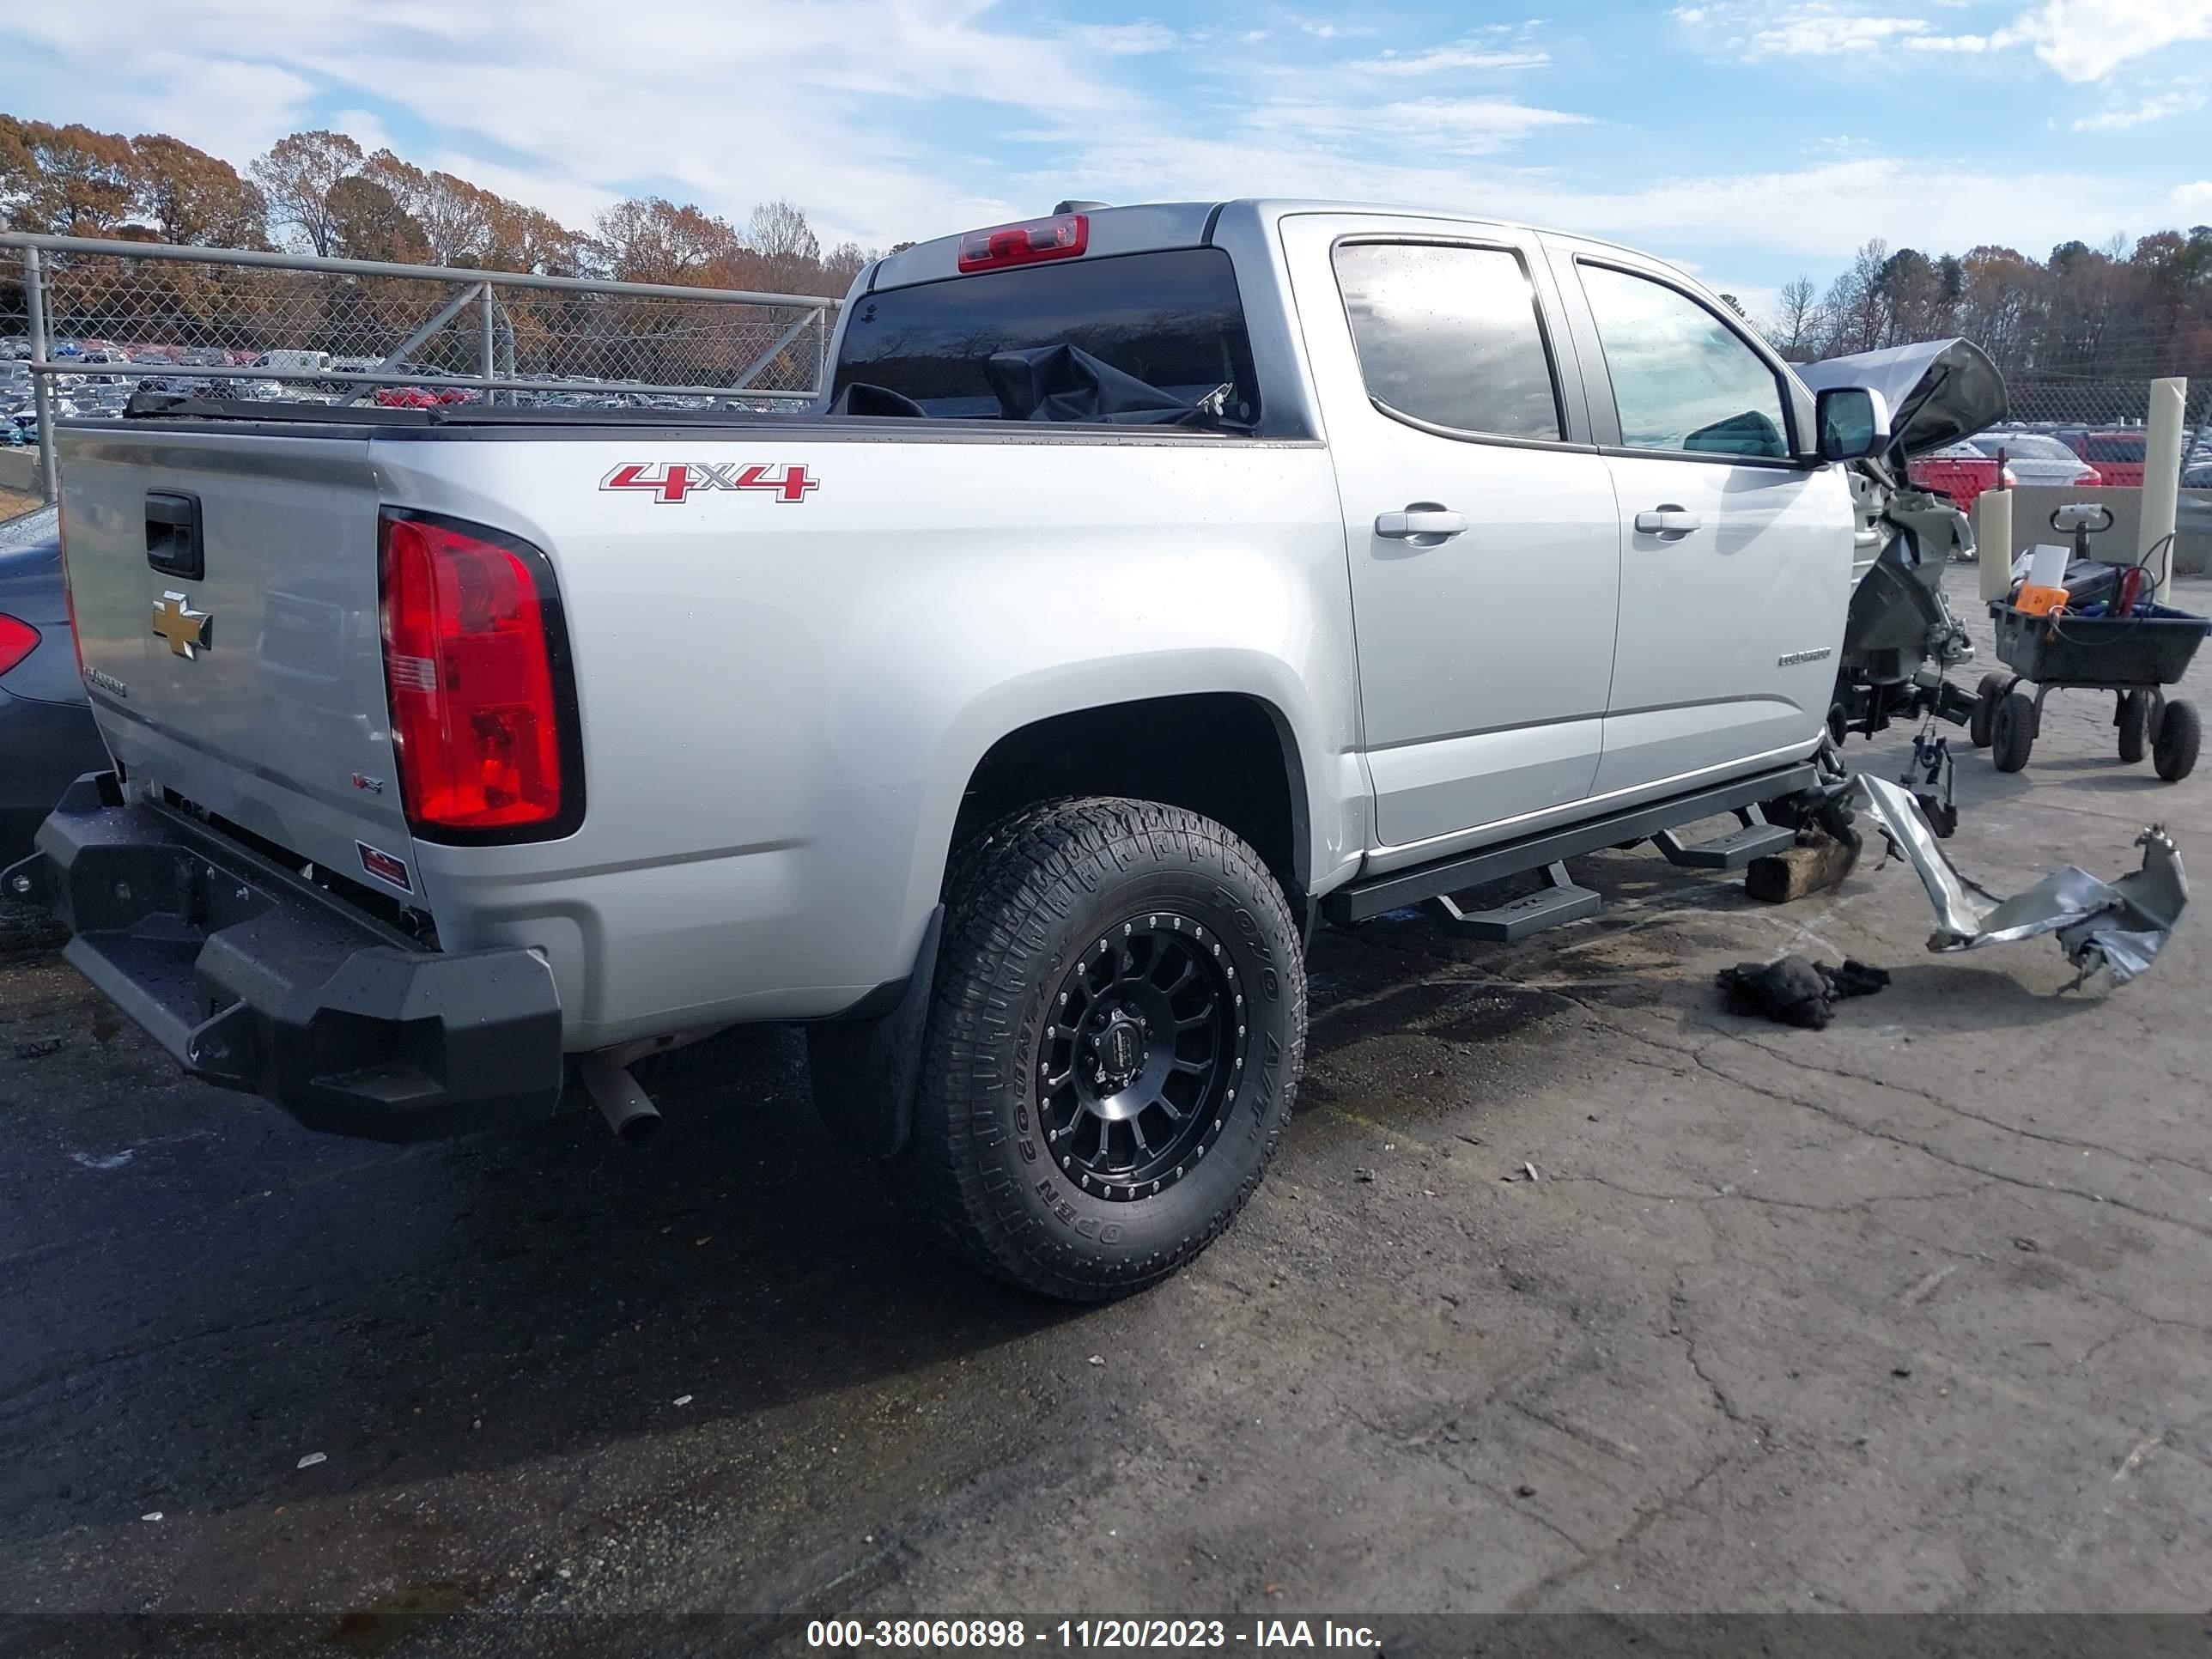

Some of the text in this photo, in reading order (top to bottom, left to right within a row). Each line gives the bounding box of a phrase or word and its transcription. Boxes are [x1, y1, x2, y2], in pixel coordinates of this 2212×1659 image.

[1209, 885, 1280, 1003] TOYO
[1014, 934, 1126, 1245] OPEN COUN
[1253, 1030, 1282, 1128] A/T
